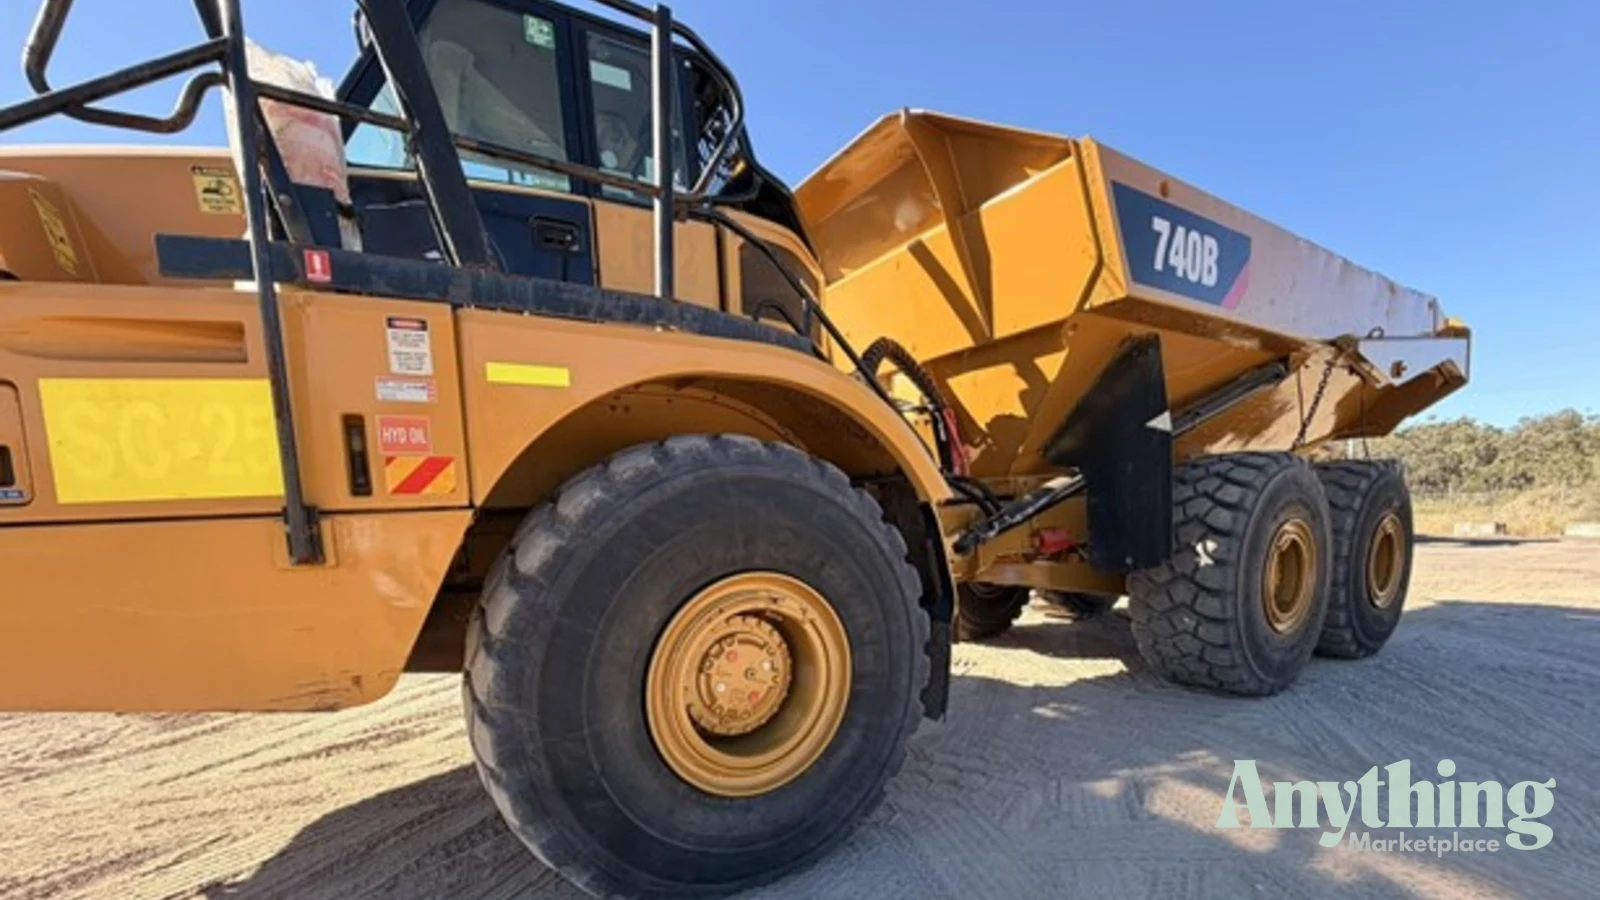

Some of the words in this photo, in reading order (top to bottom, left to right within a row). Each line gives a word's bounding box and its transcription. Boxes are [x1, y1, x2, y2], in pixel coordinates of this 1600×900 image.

[1152, 216, 1219, 288] 740B
[382, 427, 407, 444] HYD
[409, 427, 427, 444] OIL
